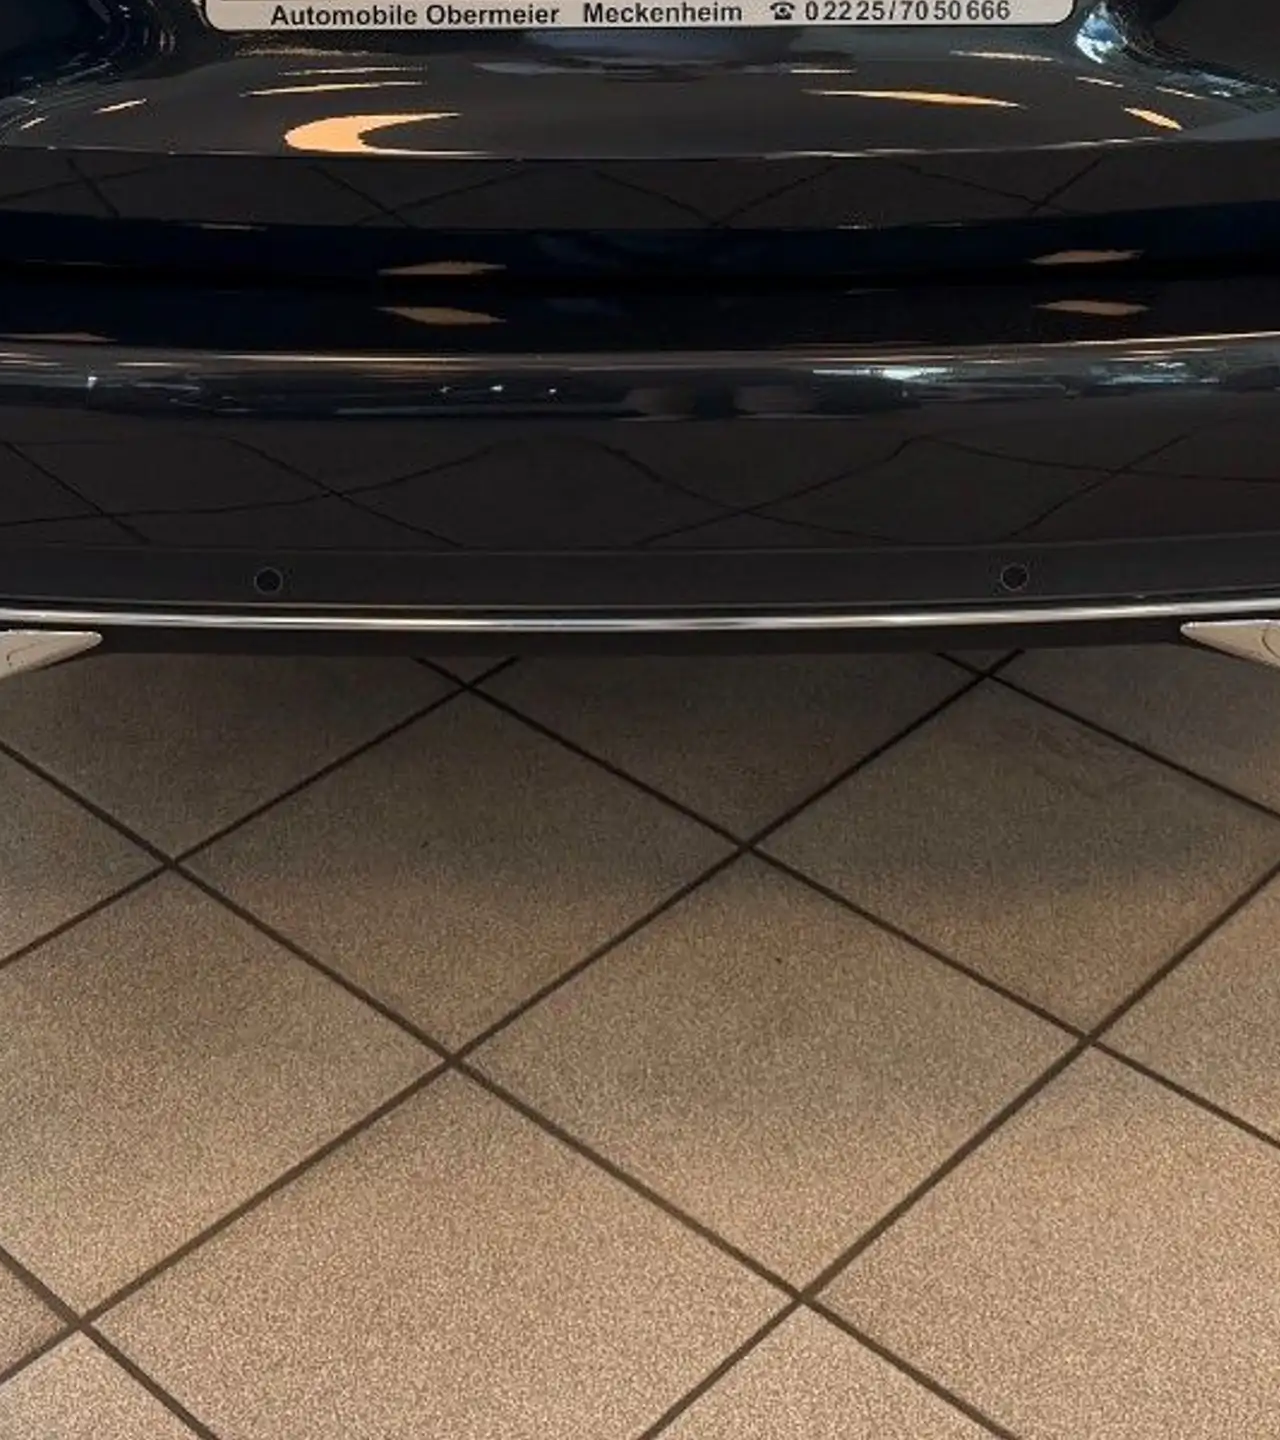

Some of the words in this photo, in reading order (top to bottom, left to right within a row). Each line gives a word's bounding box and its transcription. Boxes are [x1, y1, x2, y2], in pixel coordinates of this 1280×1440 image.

[270, 3, 418, 26] Automobile
[426, 3, 560, 26] Obermeier
[583, 1, 743, 23] Meckenheim
